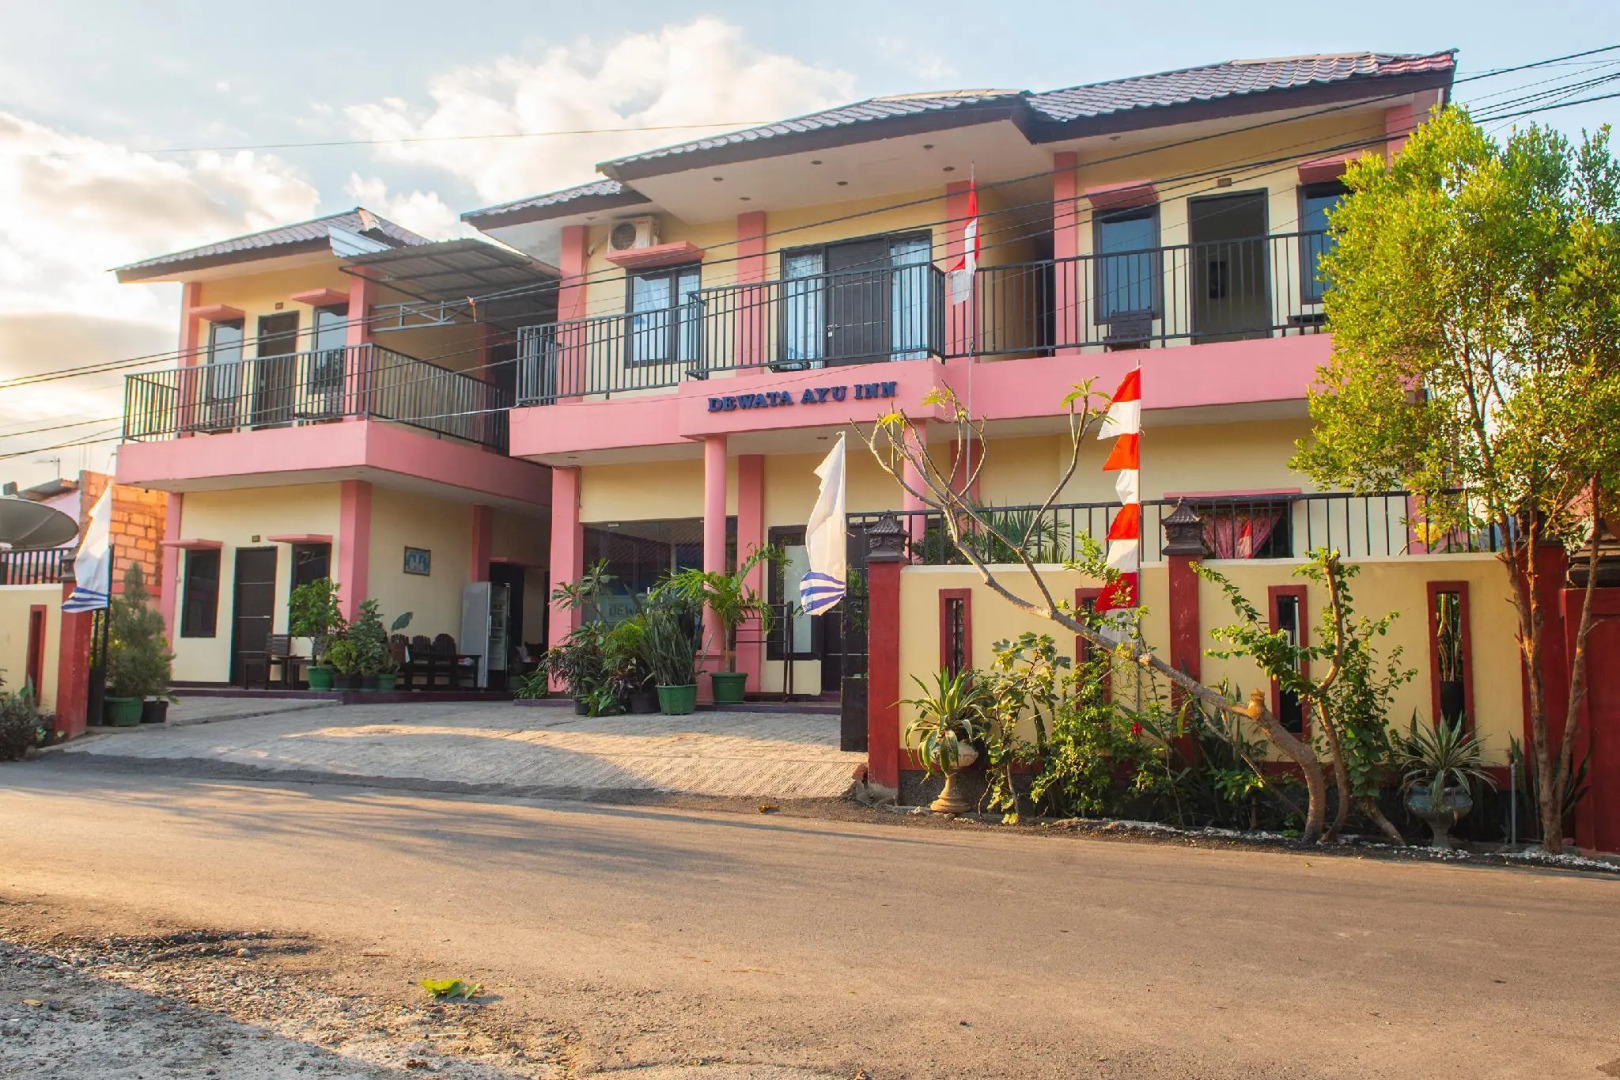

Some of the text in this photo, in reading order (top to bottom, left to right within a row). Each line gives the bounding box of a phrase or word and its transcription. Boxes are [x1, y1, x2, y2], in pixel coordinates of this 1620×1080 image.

[708, 381, 898, 412] DEWATA AYU INN
